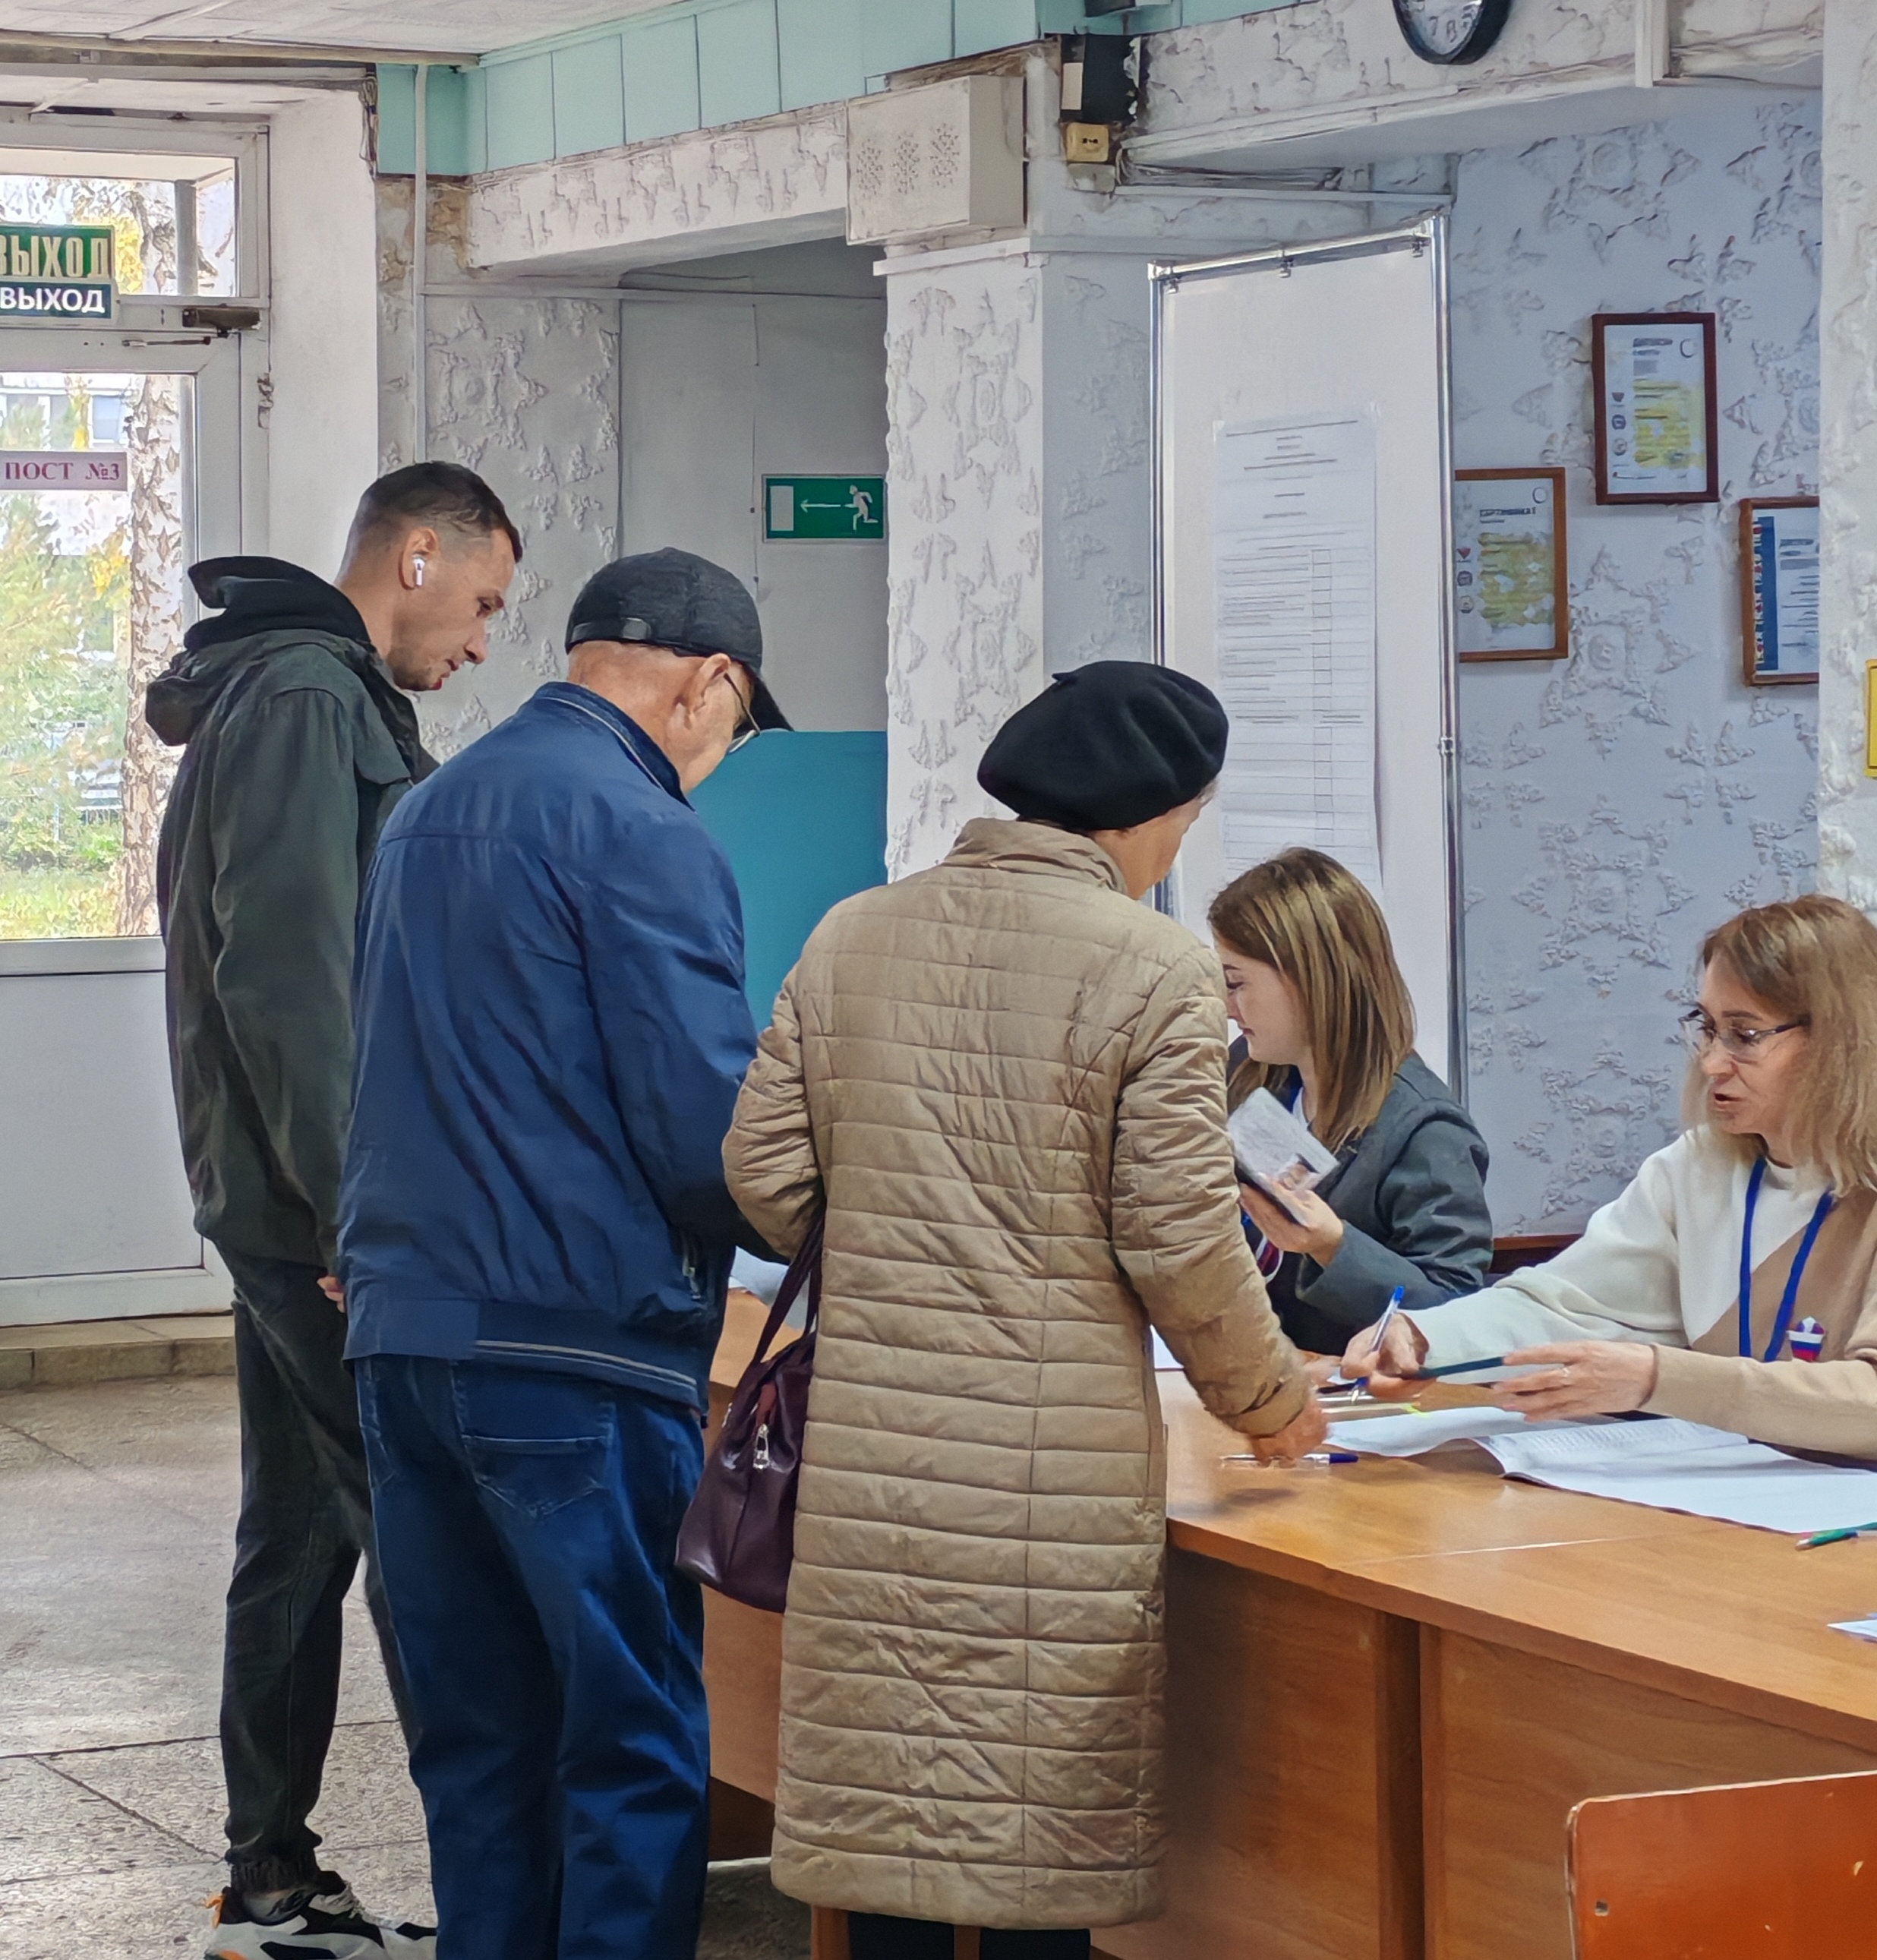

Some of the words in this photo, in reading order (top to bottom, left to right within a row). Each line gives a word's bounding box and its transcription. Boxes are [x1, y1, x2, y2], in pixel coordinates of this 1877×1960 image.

[0, 287, 106, 313] ВЫХОД
[5, 462, 74, 480] ПОСТ
[85, 462, 119, 481] №3
